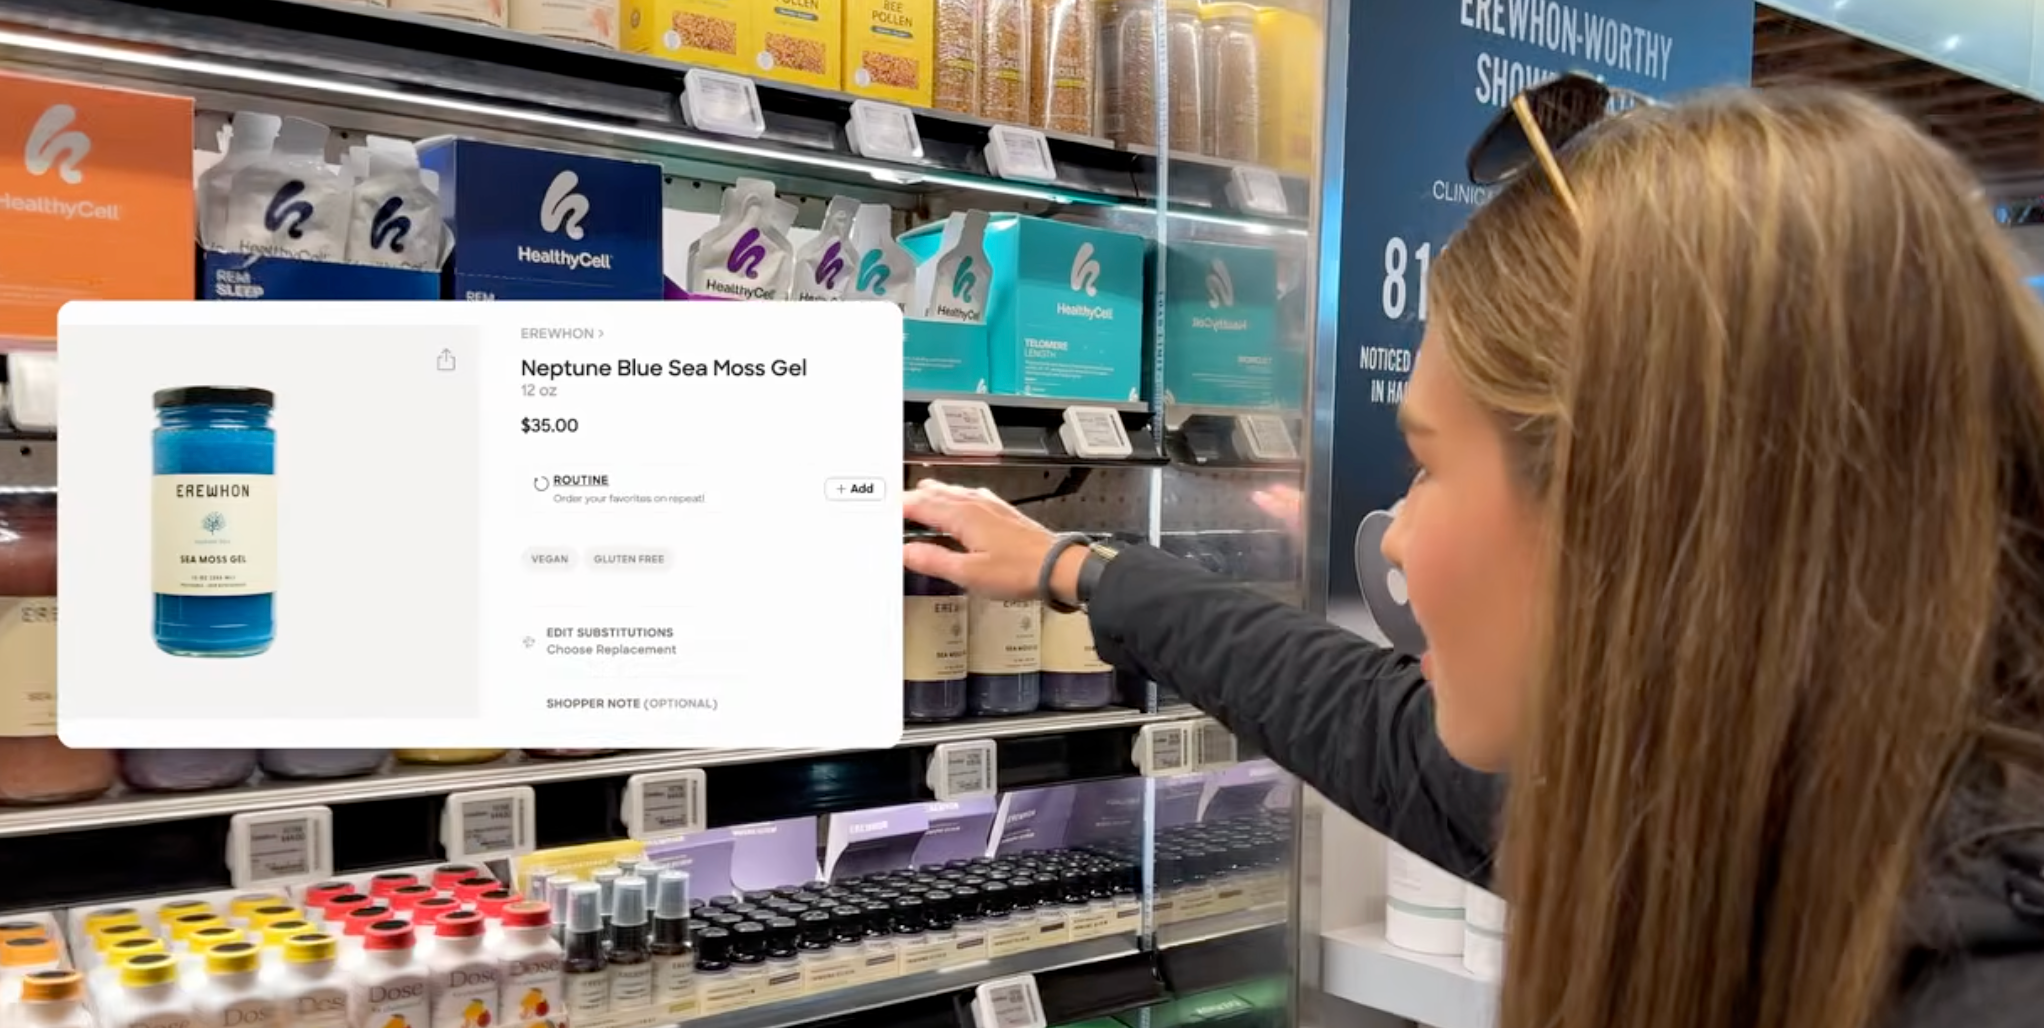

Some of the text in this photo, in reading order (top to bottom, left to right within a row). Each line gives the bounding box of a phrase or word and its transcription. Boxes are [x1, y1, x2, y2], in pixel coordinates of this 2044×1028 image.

[871, 10, 913, 28] POLLEN
[1460, 0, 1673, 82] EREWHON-WORTHY
[1432, 179, 1493, 207] CLINIC
[517, 246, 612, 270] HealthyCell
[216, 269, 250, 283] REM
[1383, 236, 1448, 321] 81
[216, 283, 264, 298] SLEEP
[1057, 302, 1114, 321] HealthyCell
[1360, 345, 1411, 372] NOTICED
[1371, 379, 1409, 404] IN HA
[508, 958, 560, 978] Dose
[369, 982, 424, 1004] Dose
[222, 1008, 268, 1027] Dos
